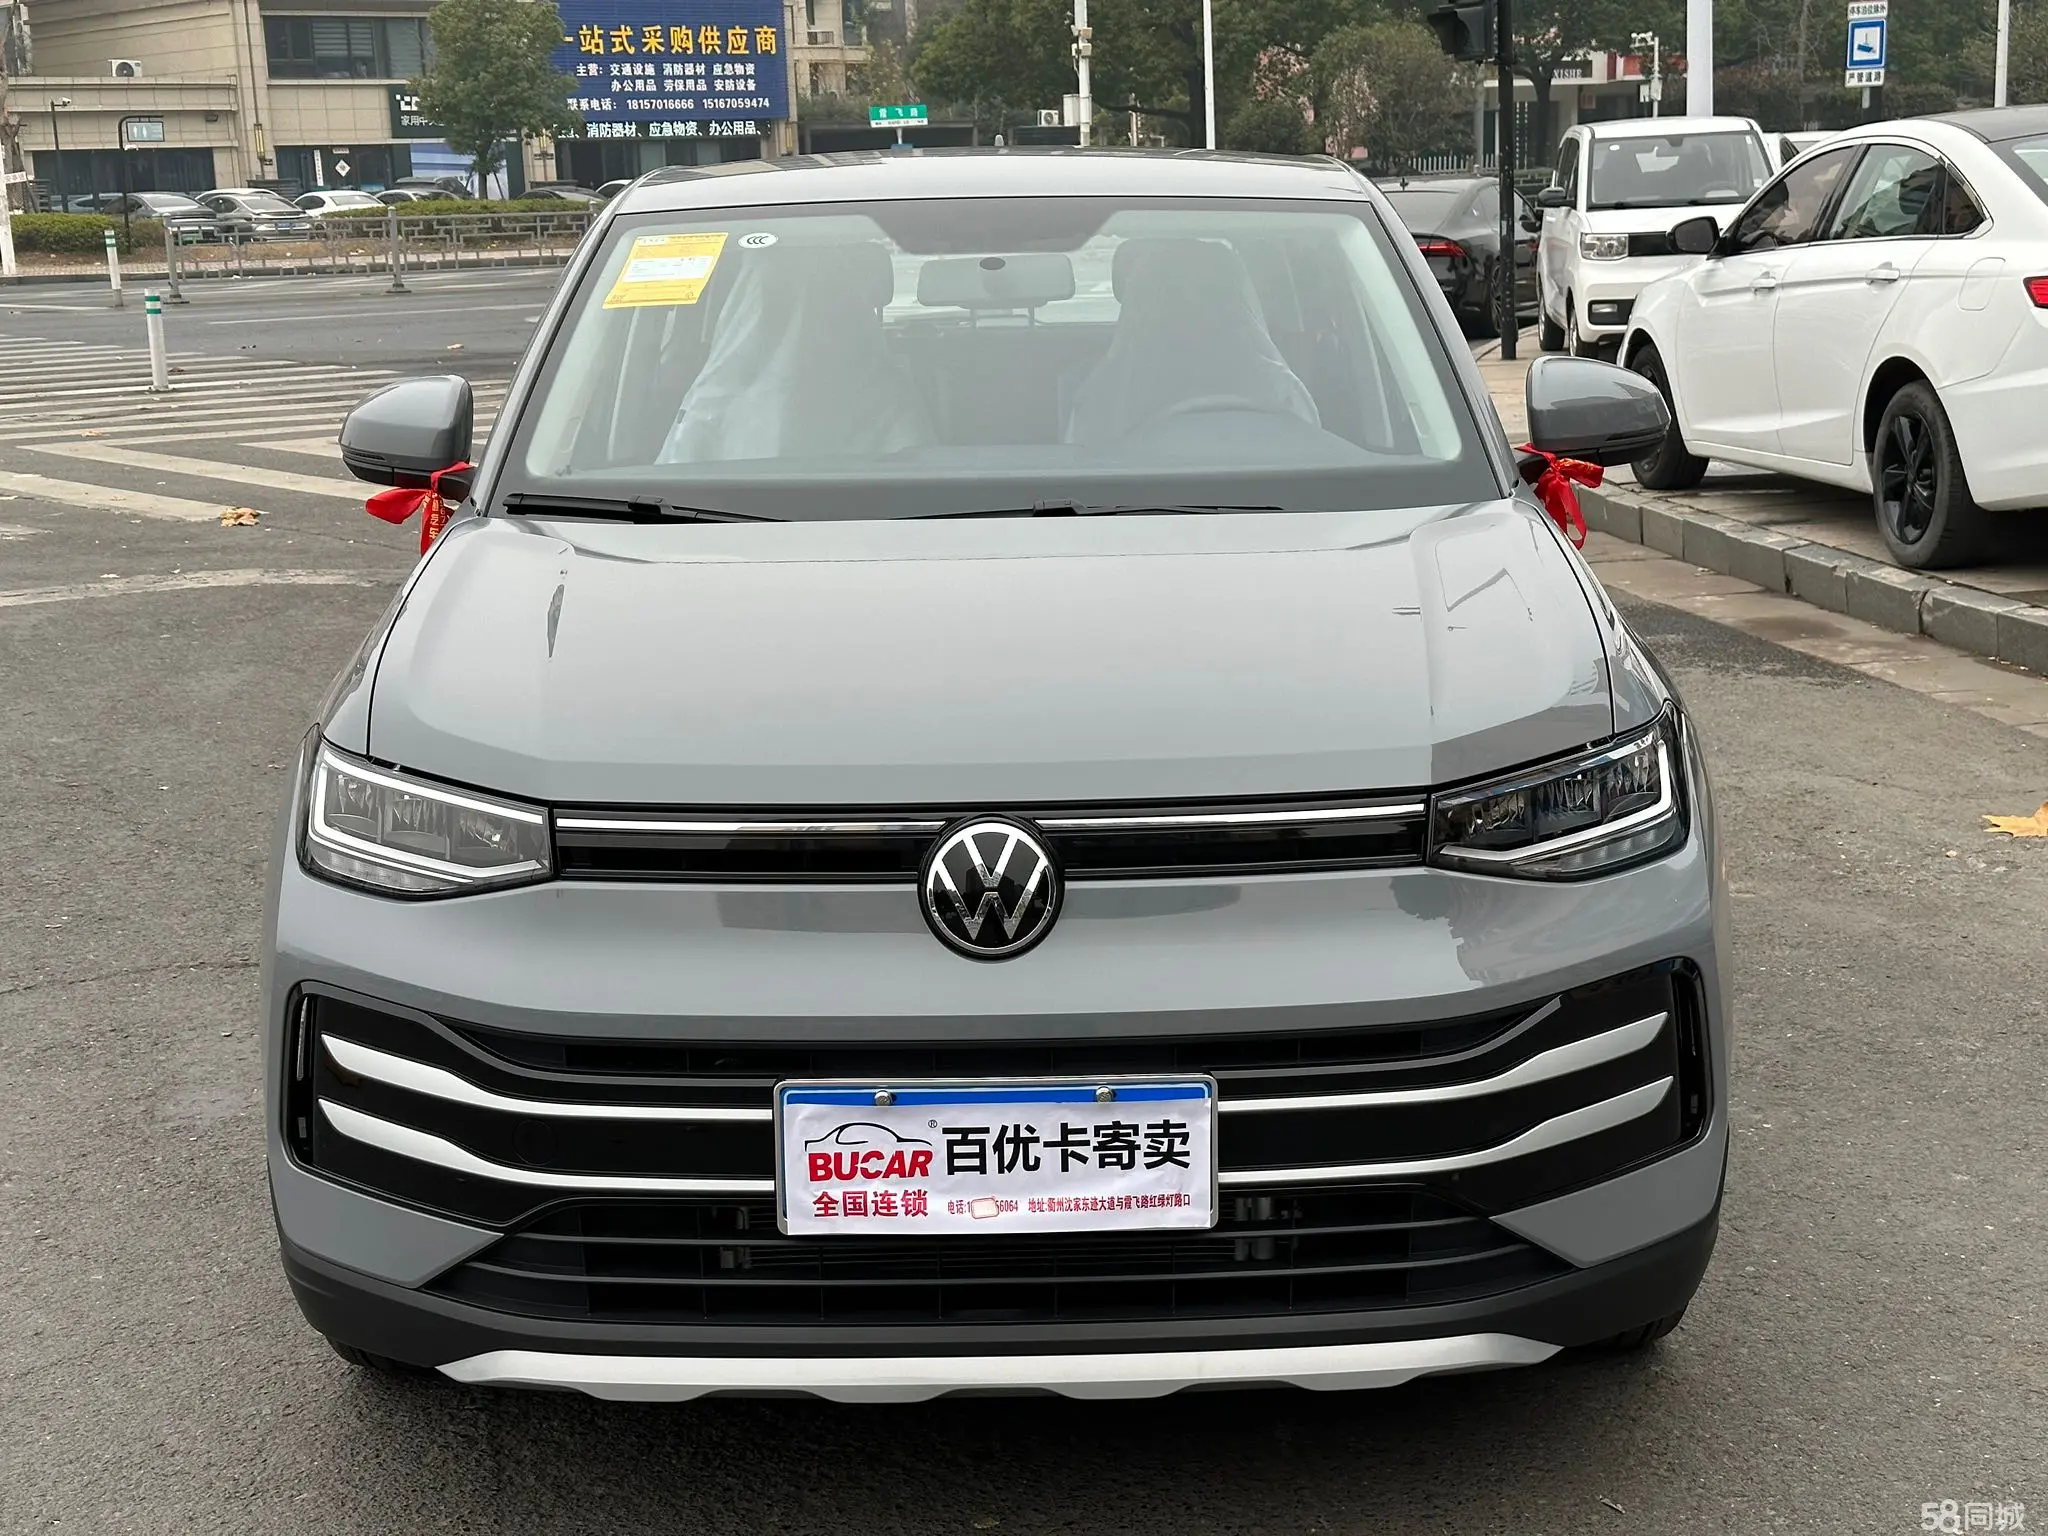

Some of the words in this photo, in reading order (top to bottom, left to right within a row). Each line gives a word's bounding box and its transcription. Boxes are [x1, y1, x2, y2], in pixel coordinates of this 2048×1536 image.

[609, 63, 655, 76] 交通设施
[662, 63, 706, 76] 消防器材
[712, 63, 755, 75] 应急物资
[611, 80, 657, 92] 办公用品
[663, 79, 707, 91] 劳保用品
[713, 79, 757, 91] 安防设备
[626, 98, 694, 110] 18157016666
[702, 98, 770, 109] 15167059474
[942, 1118, 1191, 1176] 百优卡寄卖
[808, 1150, 934, 1182] BUCAR
[812, 1190, 929, 1219] 全国连锁
